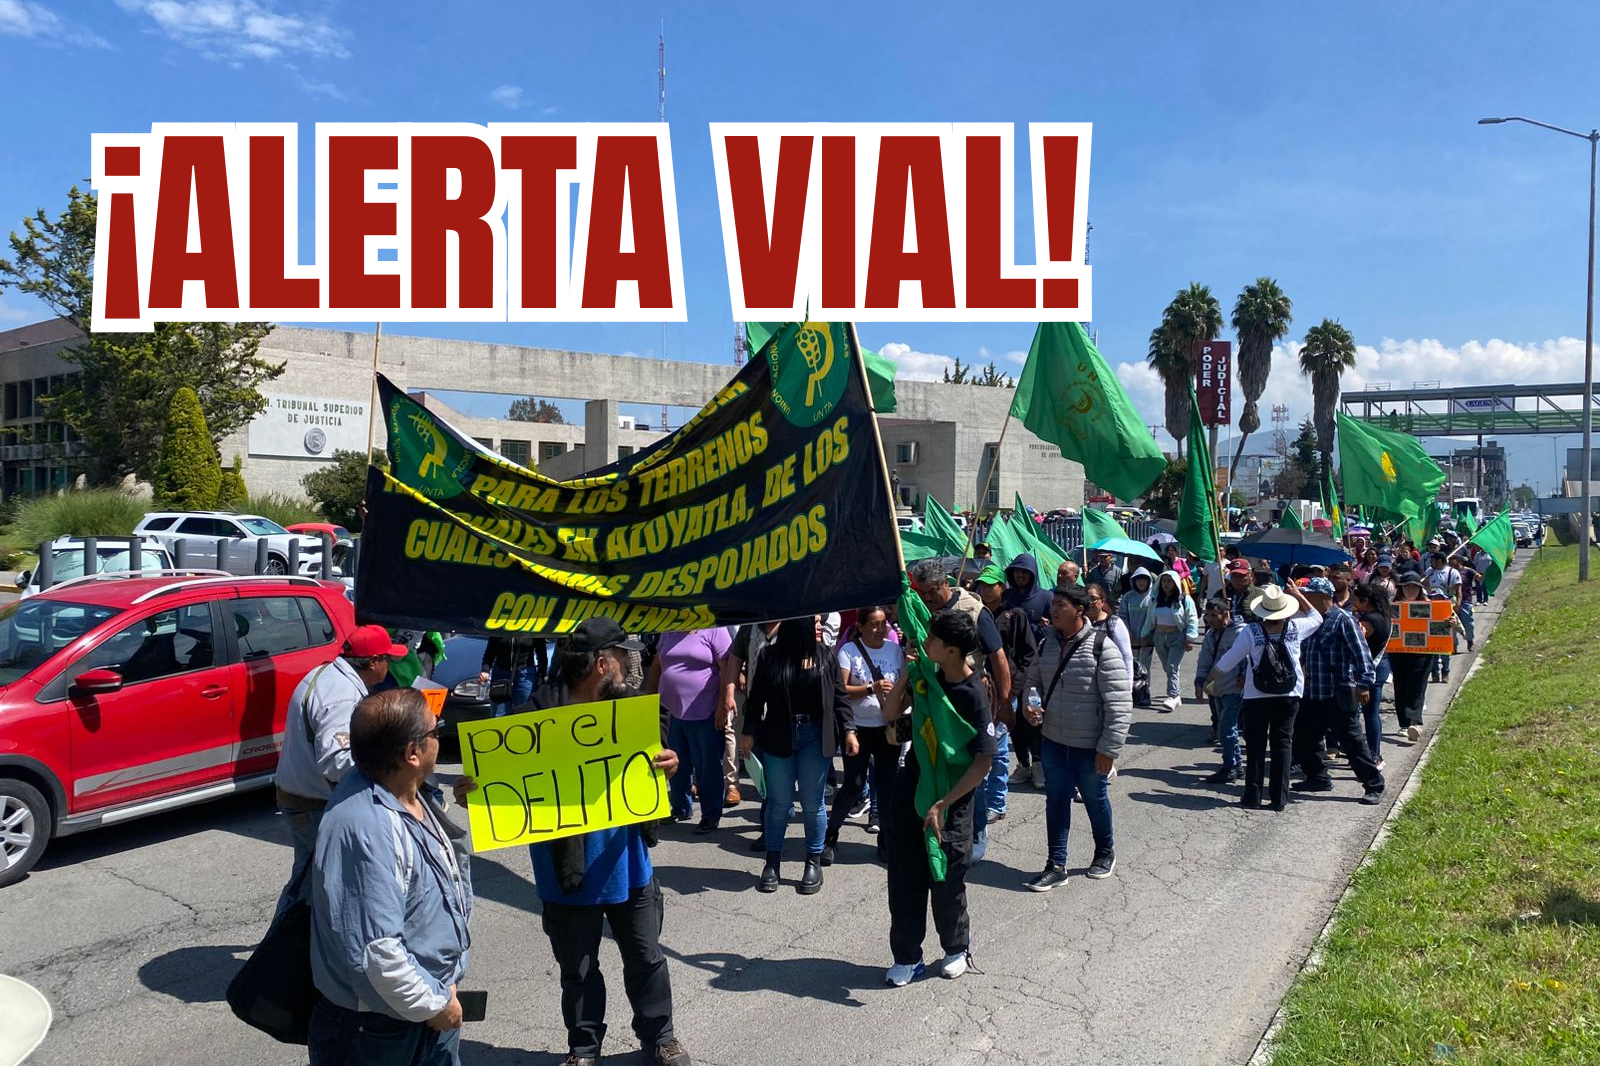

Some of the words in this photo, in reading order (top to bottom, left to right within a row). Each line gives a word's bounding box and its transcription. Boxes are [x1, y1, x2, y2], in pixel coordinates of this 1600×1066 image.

[1202, 346, 1212, 387] PODER
[1216, 356, 1227, 418] JUDICIAL
[276, 399, 319, 412] TRIBUNAL
[323, 403, 364, 416] SUPERIOR
[287, 413, 299, 423] DE
[303, 415, 343, 426] JUSTICIA
[813, 401, 833, 422] UNTA
[471, 473, 560, 514] PARA
[567, 478, 630, 515] LOS
[638, 411, 769, 507] TERRENOS
[557, 527, 600, 562] EN
[607, 483, 755, 561] AZOYATLA,
[762, 453, 797, 508] DE
[803, 415, 850, 487] LOS
[419, 484, 445, 497] UNTA
[630, 503, 828, 598] DESPOJADOS
[485, 592, 560, 633] CON
[467, 718, 556, 777] por
[571, 700, 618, 747] el
[483, 750, 660, 843] DELITO
